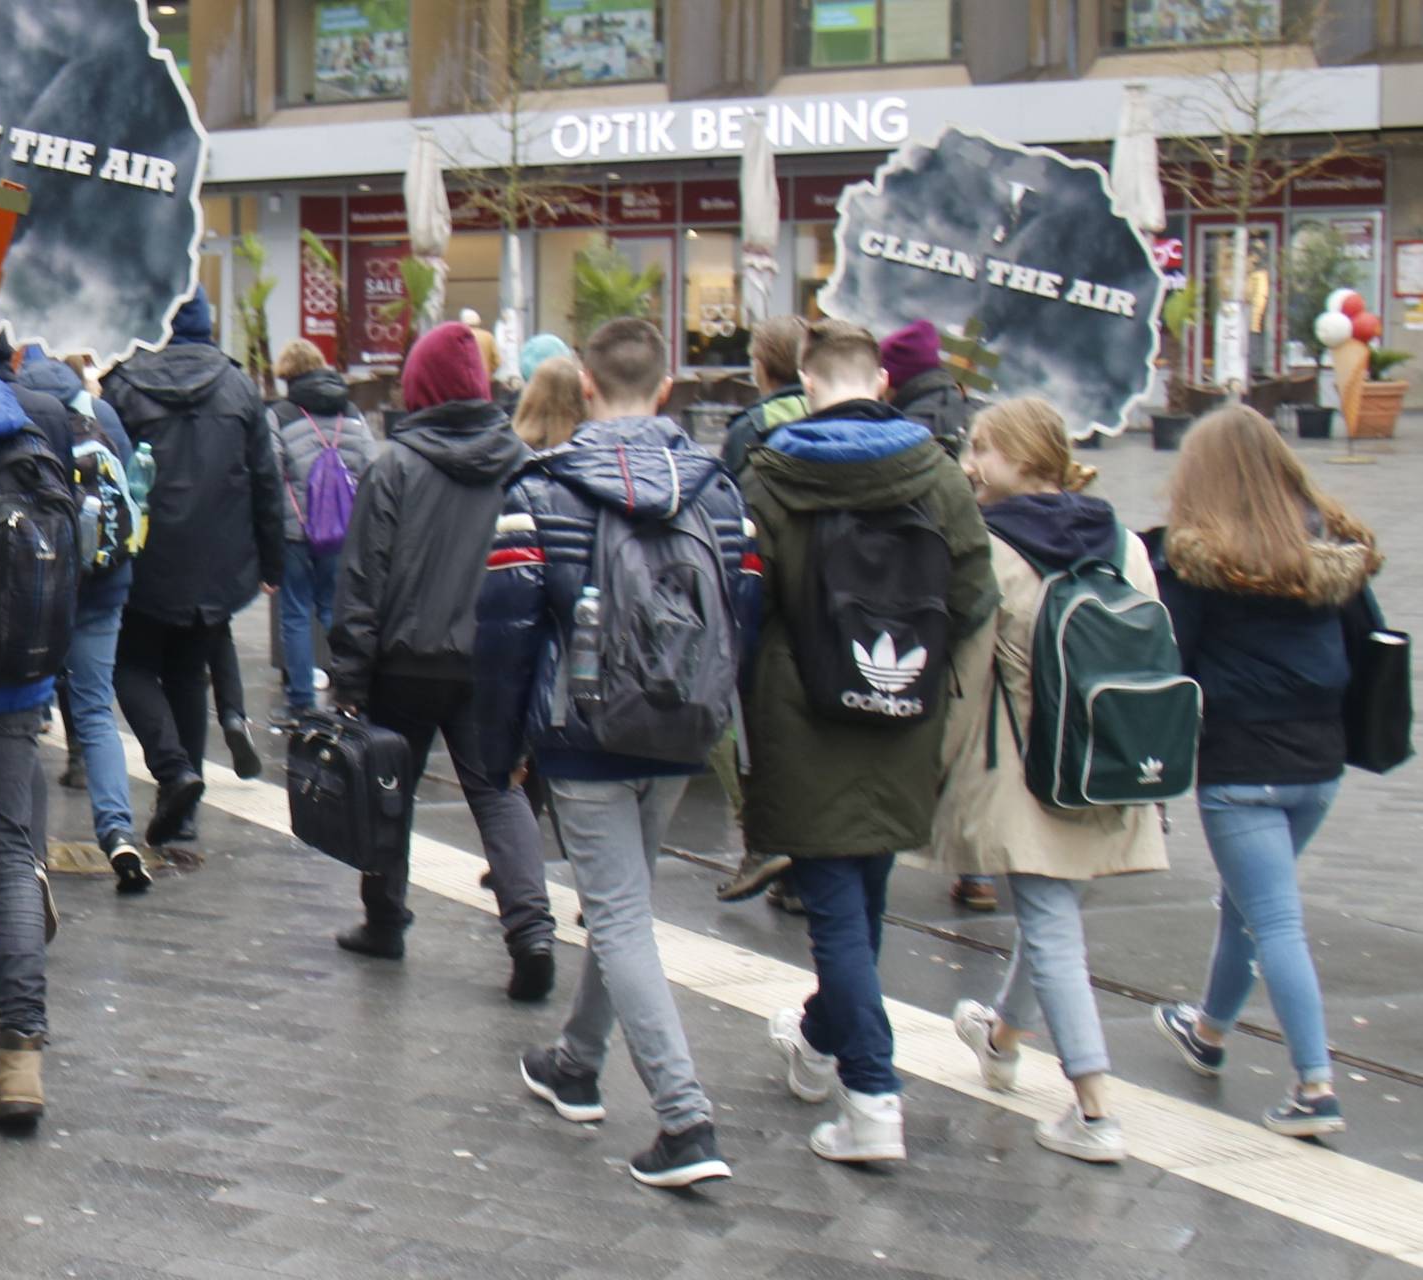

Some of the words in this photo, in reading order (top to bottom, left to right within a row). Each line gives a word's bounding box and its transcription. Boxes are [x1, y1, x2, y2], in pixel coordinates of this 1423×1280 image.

[550, 109, 676, 159] OPTIK
[9, 127, 97, 177] THE
[99, 147, 177, 194] AIR
[364, 278, 404, 295] SALE
[859, 230, 977, 280] CLEAN
[986, 258, 1064, 299] THE
[1065, 278, 1138, 318] AIR
[841, 689, 924, 718] adidas
